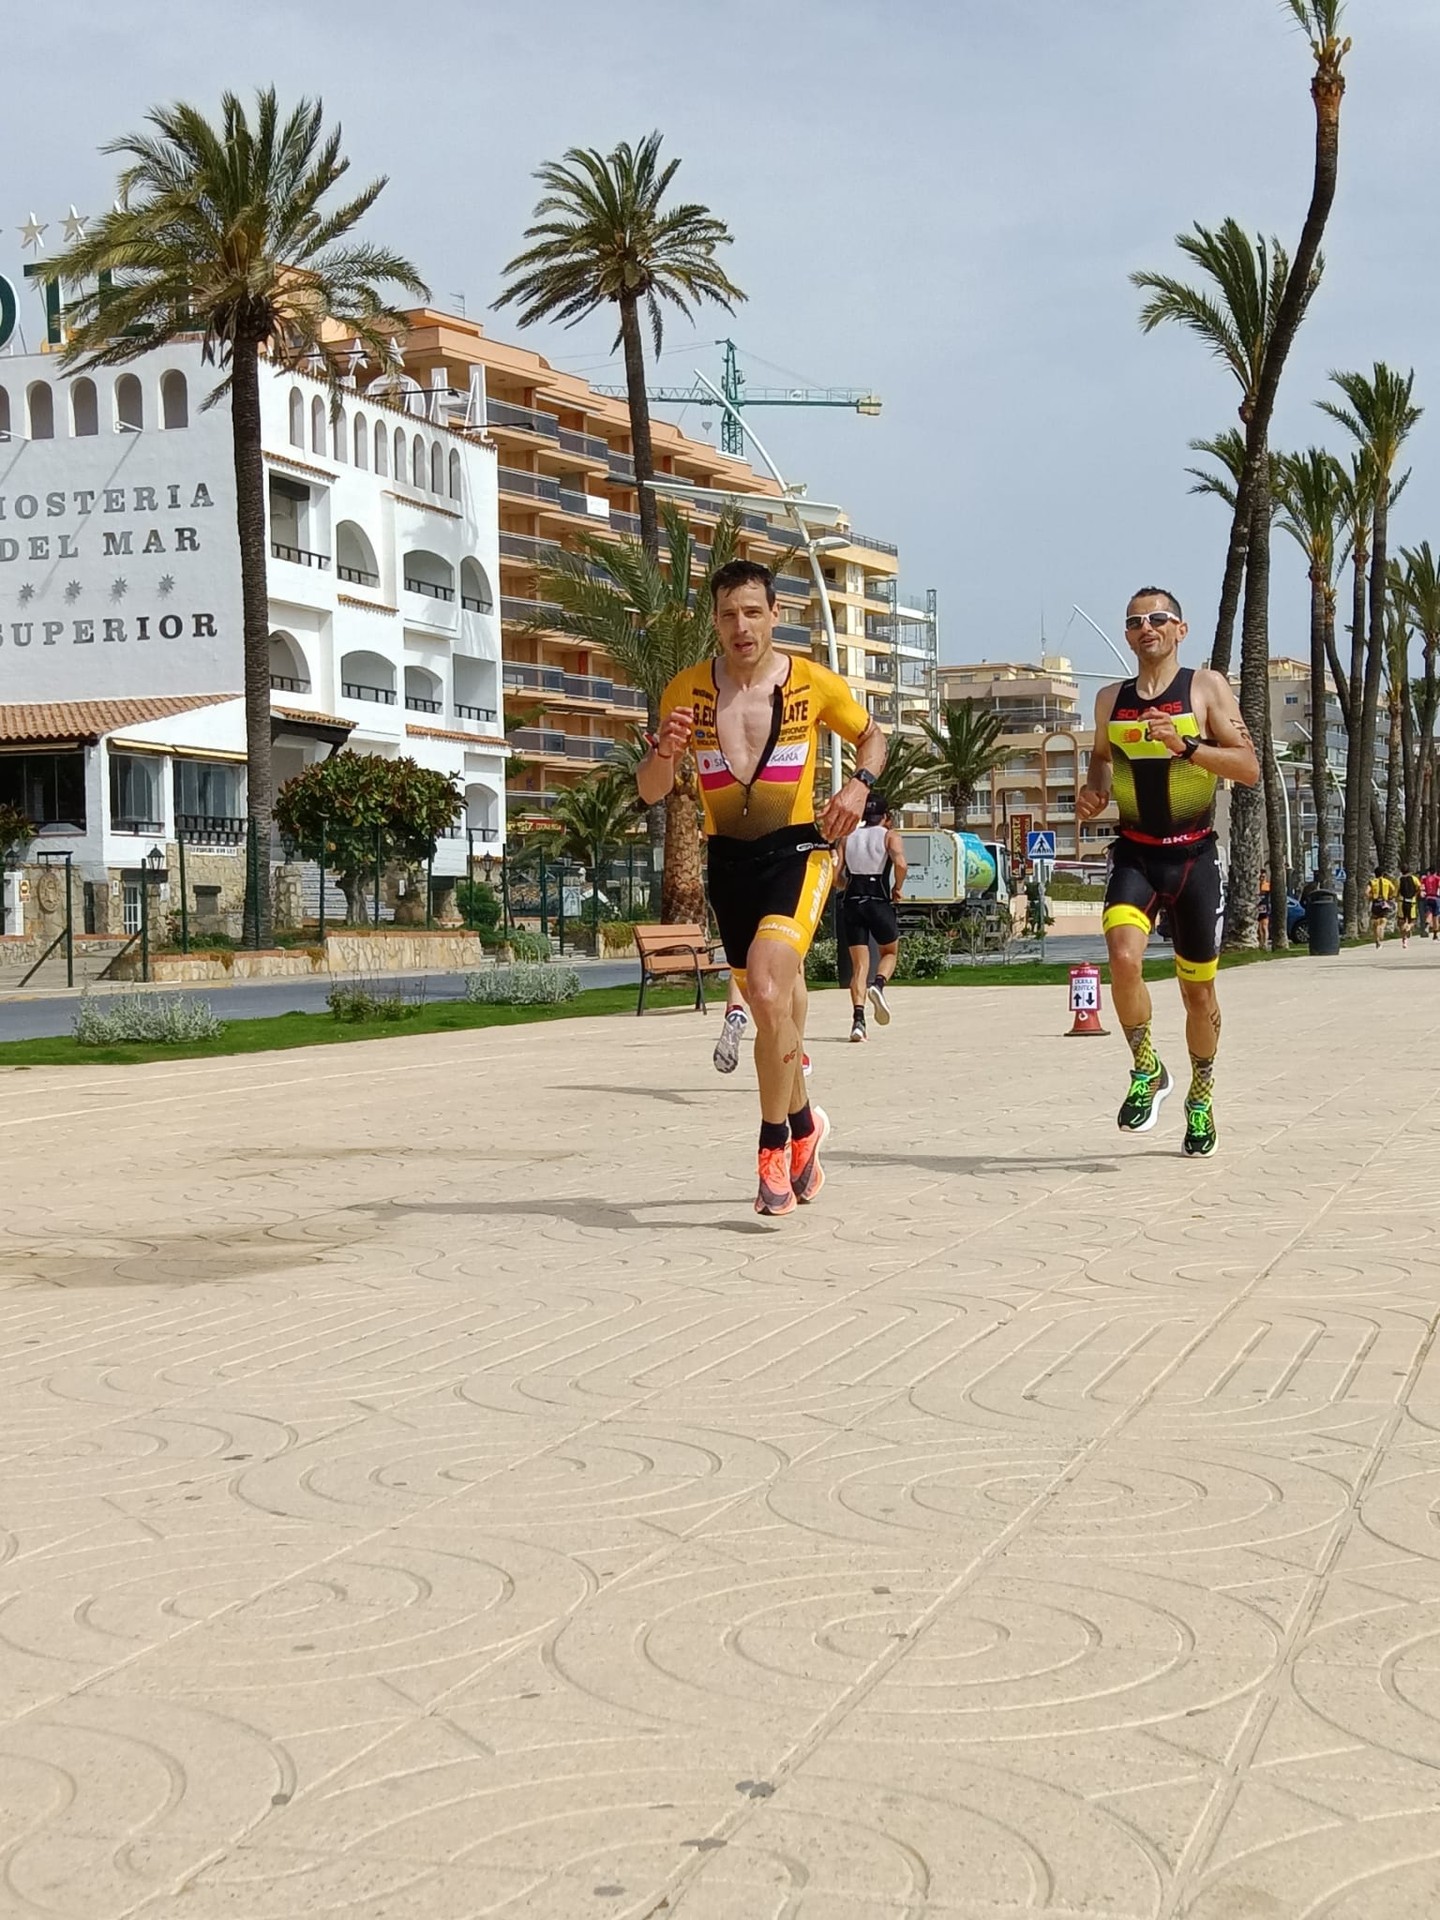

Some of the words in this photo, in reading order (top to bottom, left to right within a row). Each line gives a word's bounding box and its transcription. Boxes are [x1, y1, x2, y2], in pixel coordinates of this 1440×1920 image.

[0, 482, 214, 520] OSTERIA
[103, 526, 200, 557] MAR
[0, 612, 218, 648] UPERIOR
